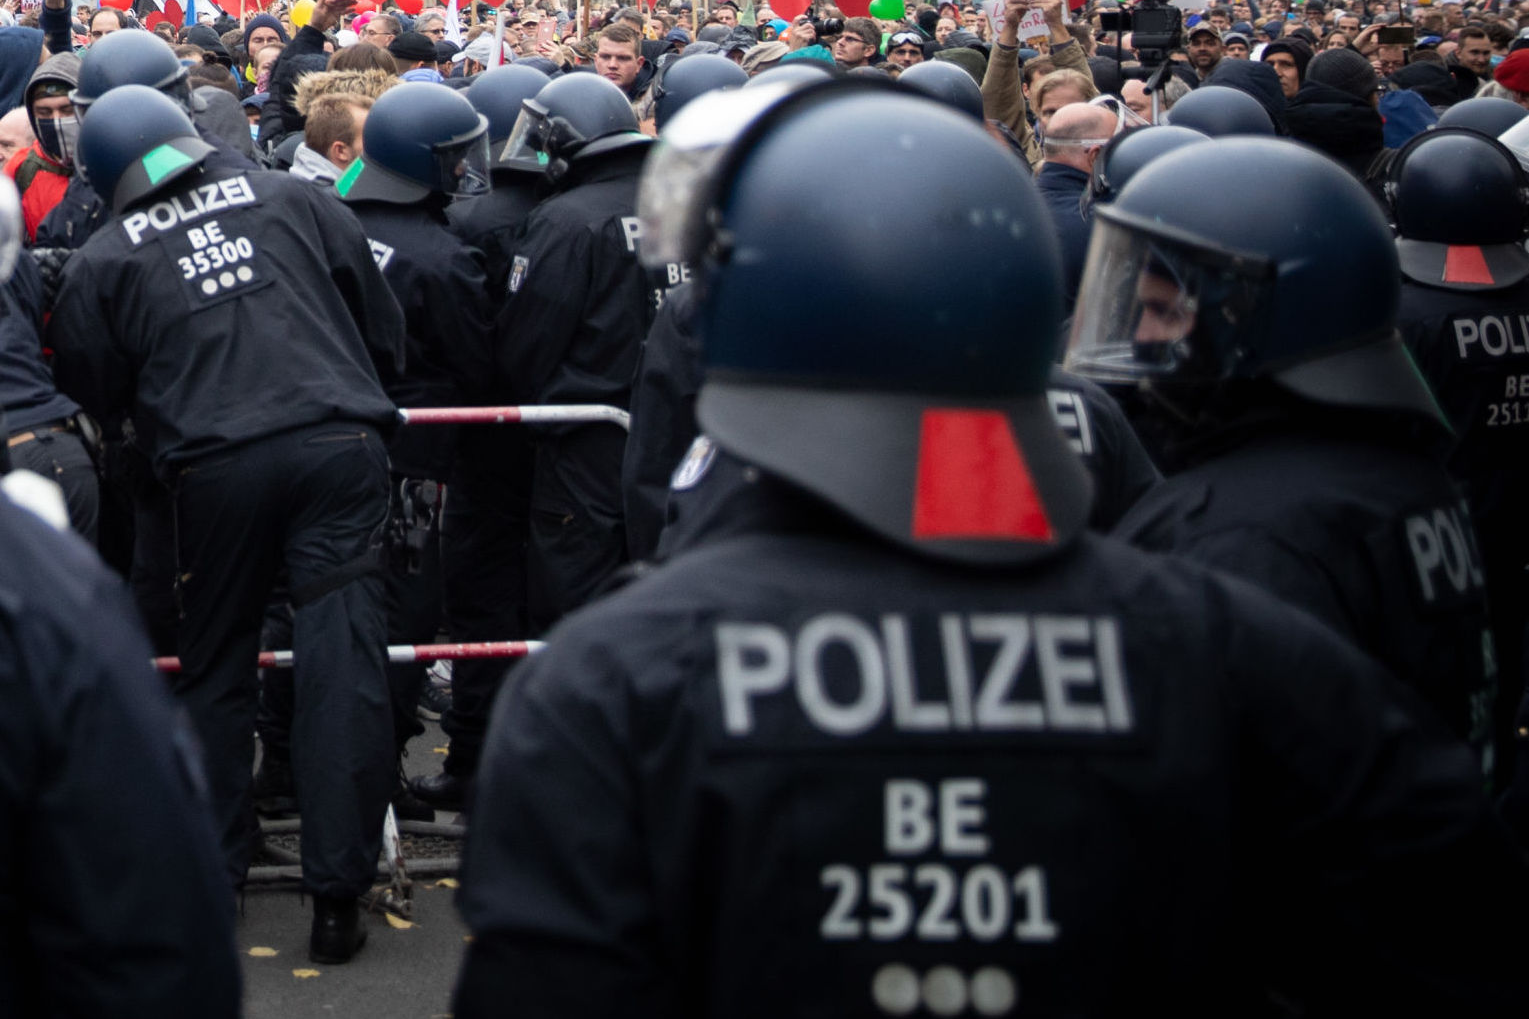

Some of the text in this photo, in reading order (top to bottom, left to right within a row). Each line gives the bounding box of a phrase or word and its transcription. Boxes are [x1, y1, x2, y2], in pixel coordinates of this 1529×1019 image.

[123, 176, 256, 244] POLIZEI
[187, 220, 225, 249] BE
[178, 237, 253, 279] 35300
[667, 263, 691, 284] BE
[1453, 315, 1529, 358] POLI
[1505, 375, 1529, 398] BE
[715, 614, 1132, 735] POLIZEI
[885, 780, 989, 854] BE
[819, 866, 1058, 939] 25201
